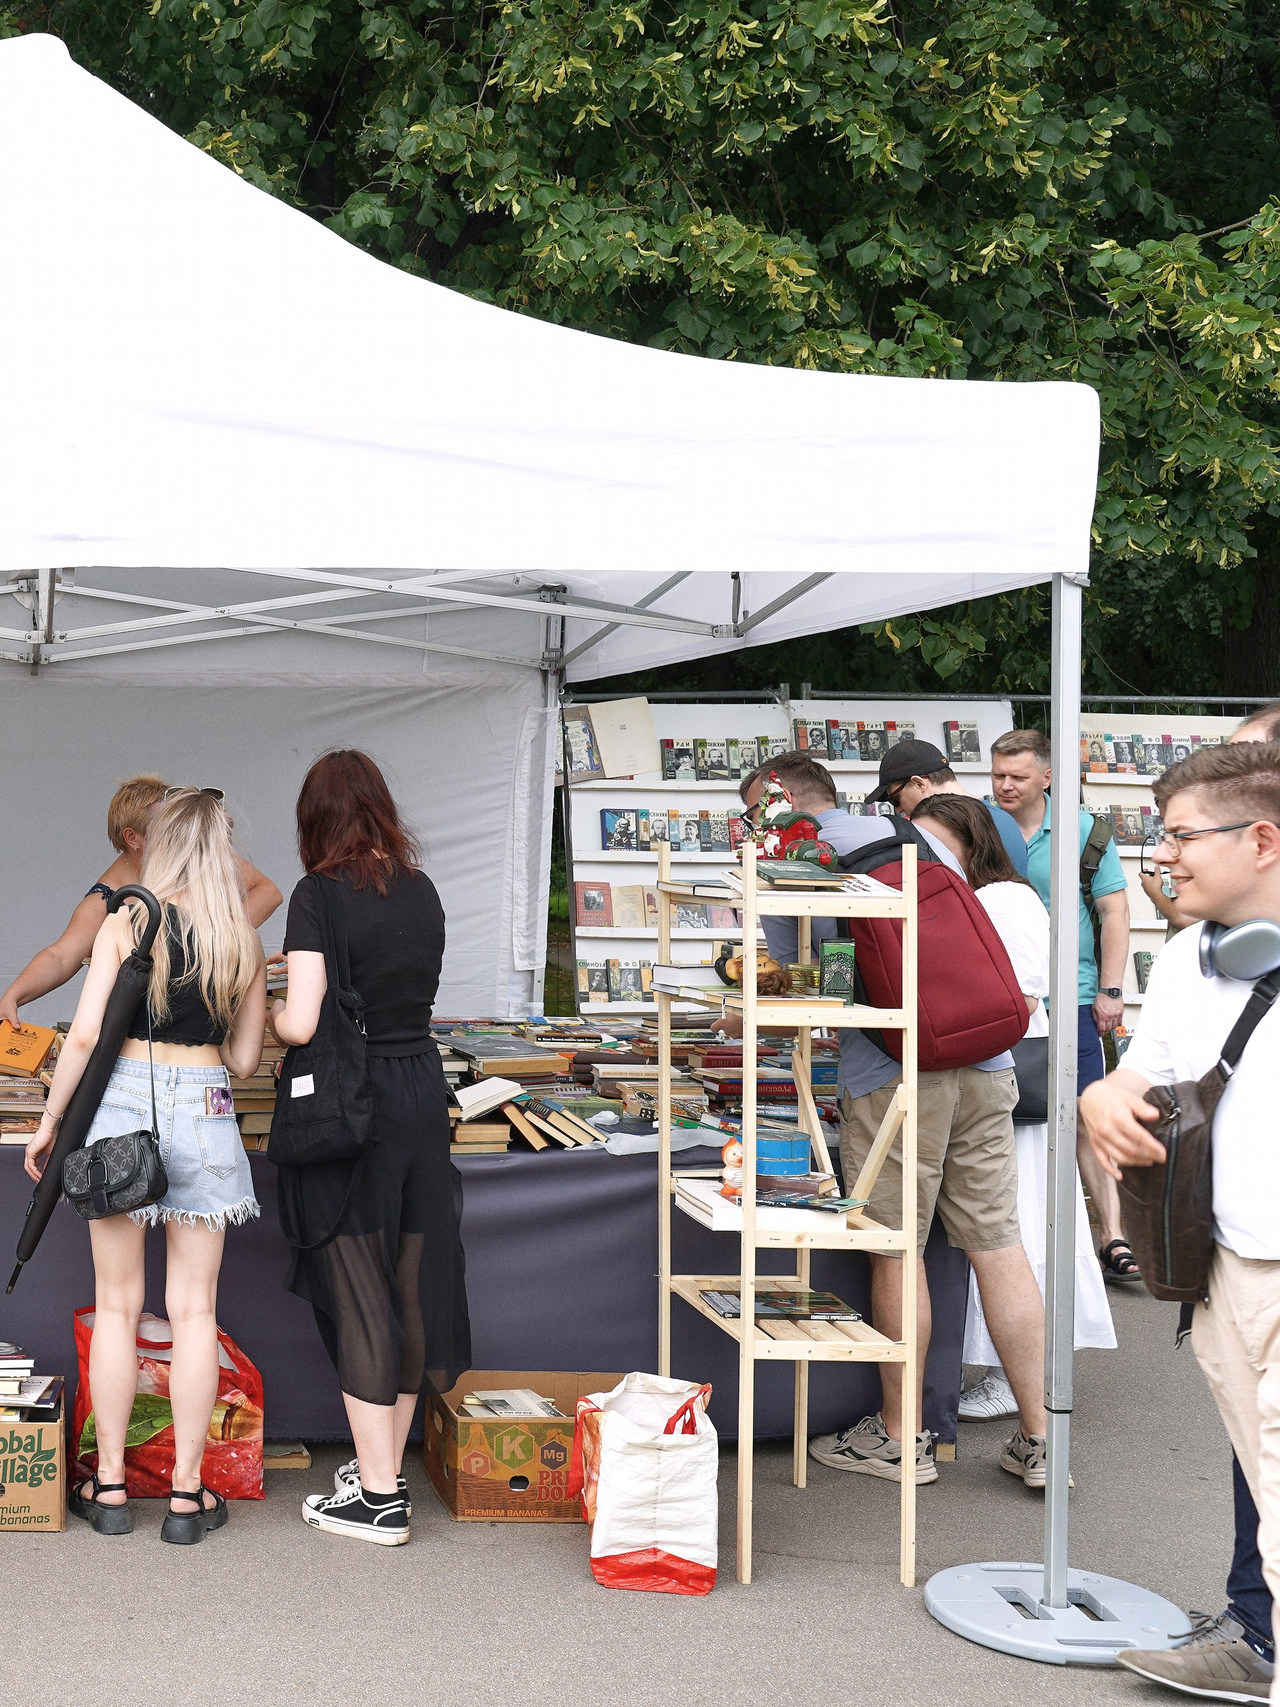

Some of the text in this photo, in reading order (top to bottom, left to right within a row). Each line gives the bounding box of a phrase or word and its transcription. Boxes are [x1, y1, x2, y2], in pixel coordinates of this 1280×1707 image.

[502, 1436, 526, 1460] K
[544, 1449, 564, 1462] Mg
[470, 1458, 484, 1474] P
[538, 1470, 570, 1486] PRI
[0, 1514, 50, 1525] bananas
[464, 1508, 548, 1518] PREMIUM BANANAS
